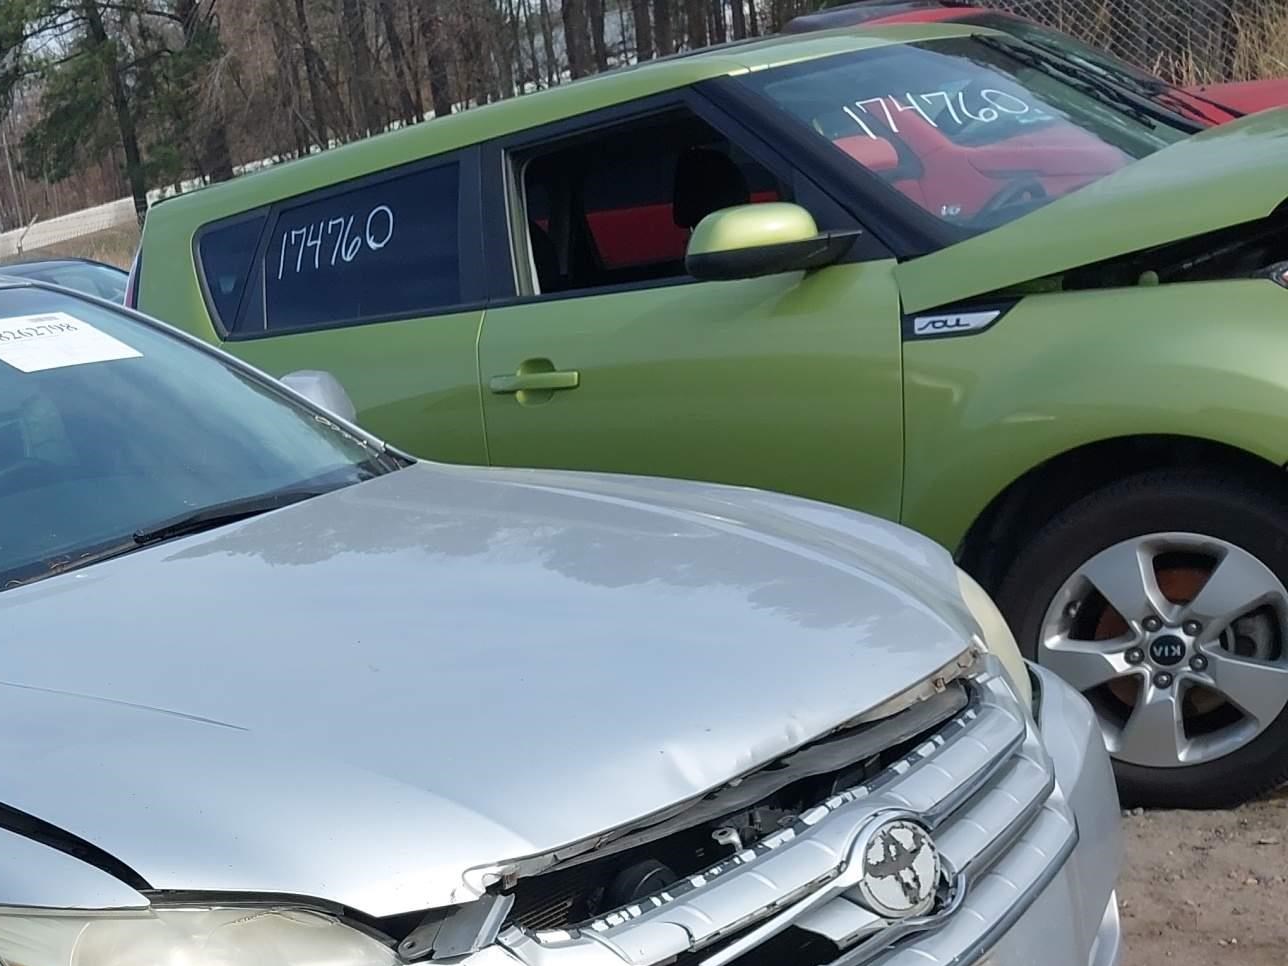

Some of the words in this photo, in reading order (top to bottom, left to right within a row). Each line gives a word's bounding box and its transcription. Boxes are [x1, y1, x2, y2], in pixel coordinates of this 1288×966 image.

[842, 88, 1030, 140] 174760
[278, 205, 394, 280] 174760
[1152, 644, 1182, 657] KIA
